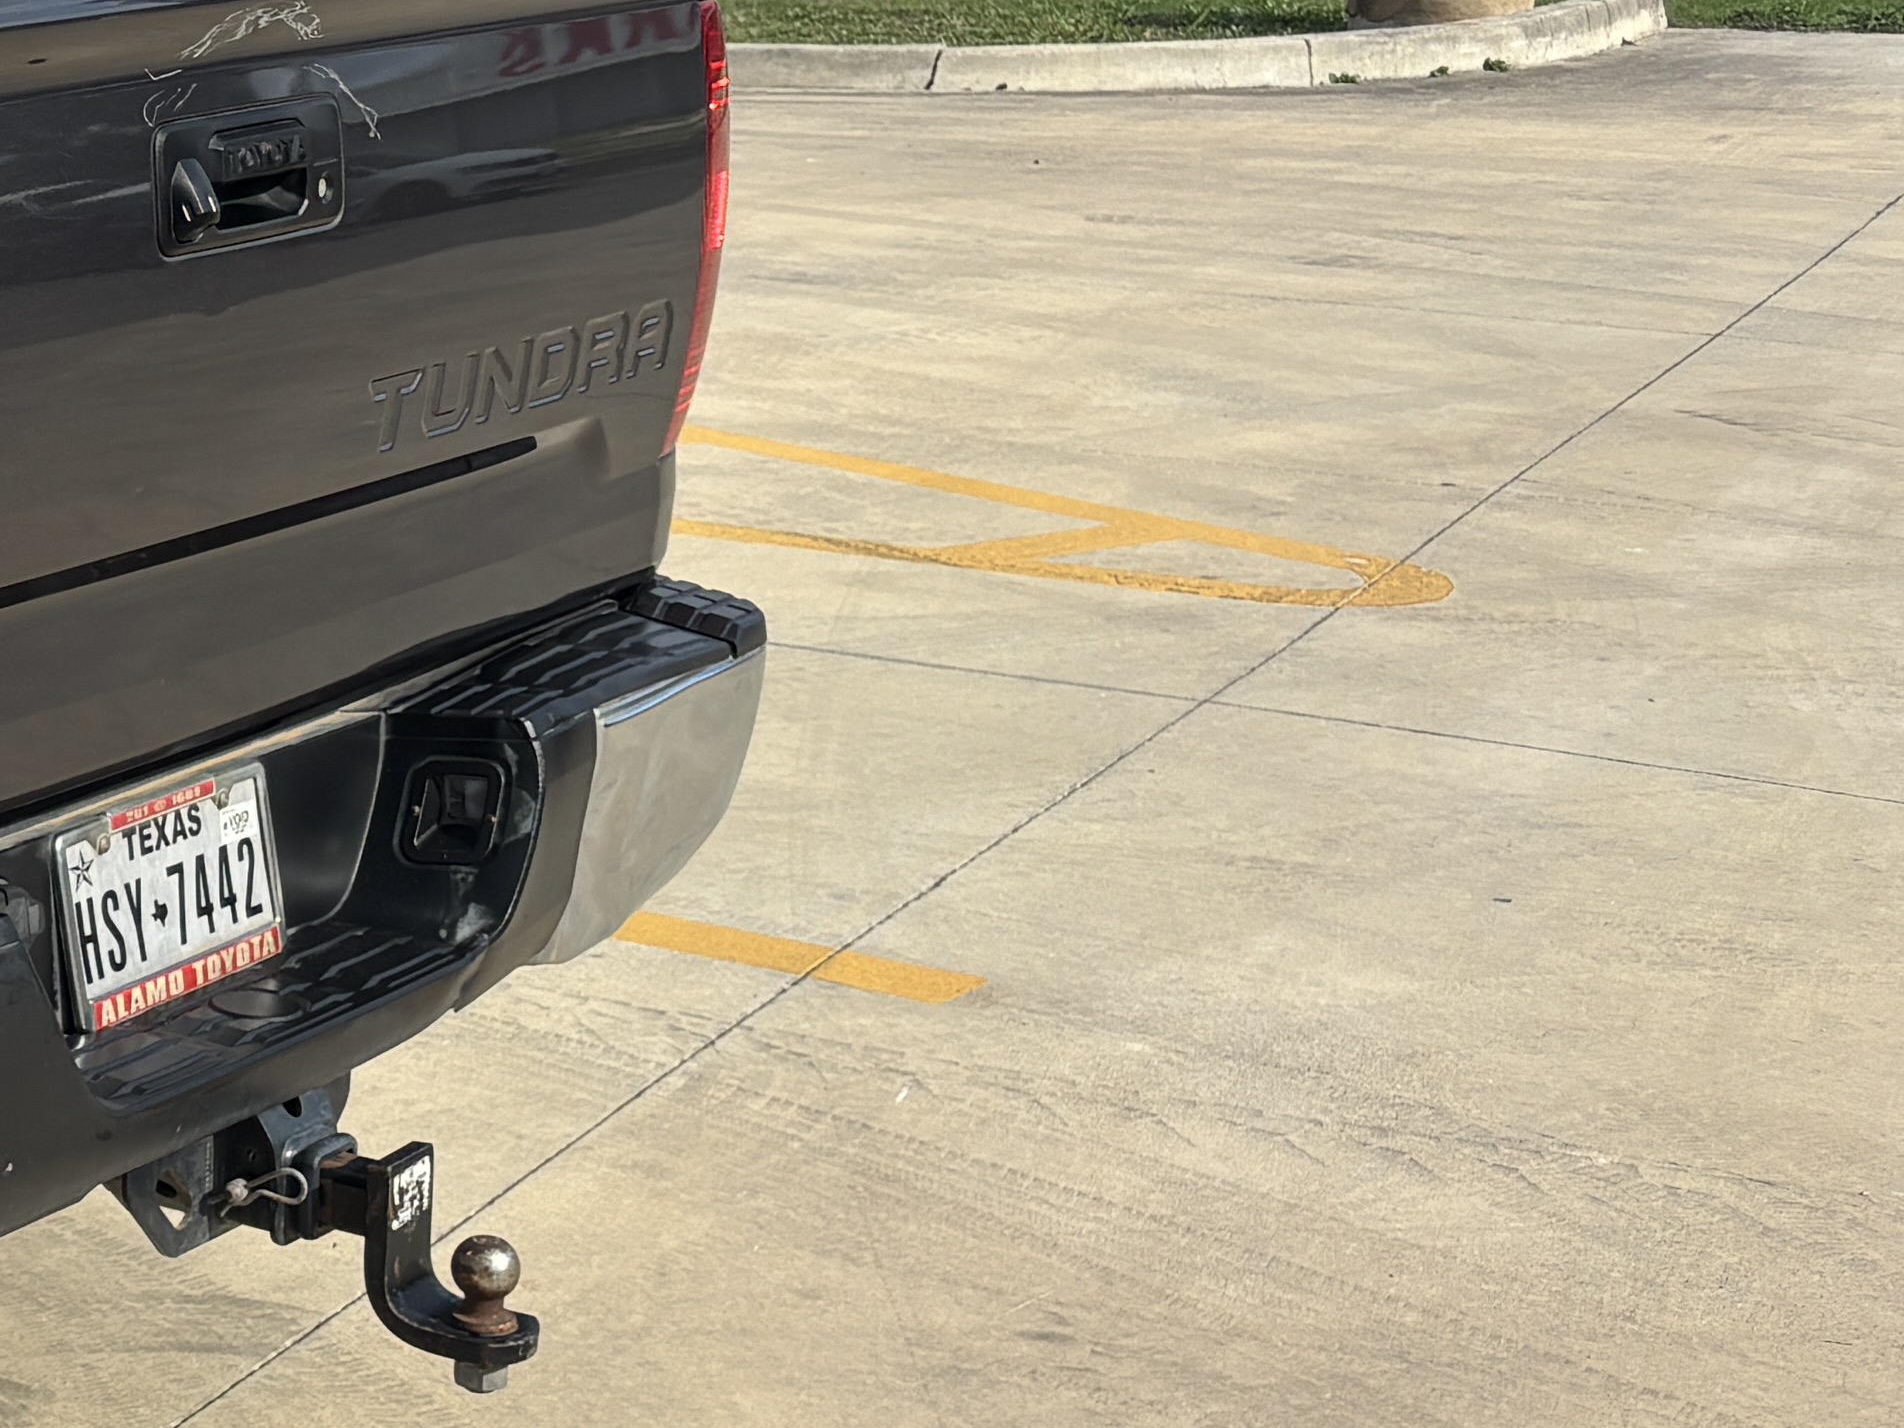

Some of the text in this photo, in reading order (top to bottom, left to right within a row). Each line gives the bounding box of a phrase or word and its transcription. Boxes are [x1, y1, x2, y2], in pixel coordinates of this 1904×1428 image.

[368, 298, 673, 452] TUNDRA
[121, 803, 202, 861] TEXAS
[101, 930, 277, 1026] ALAMO TOYOTA
